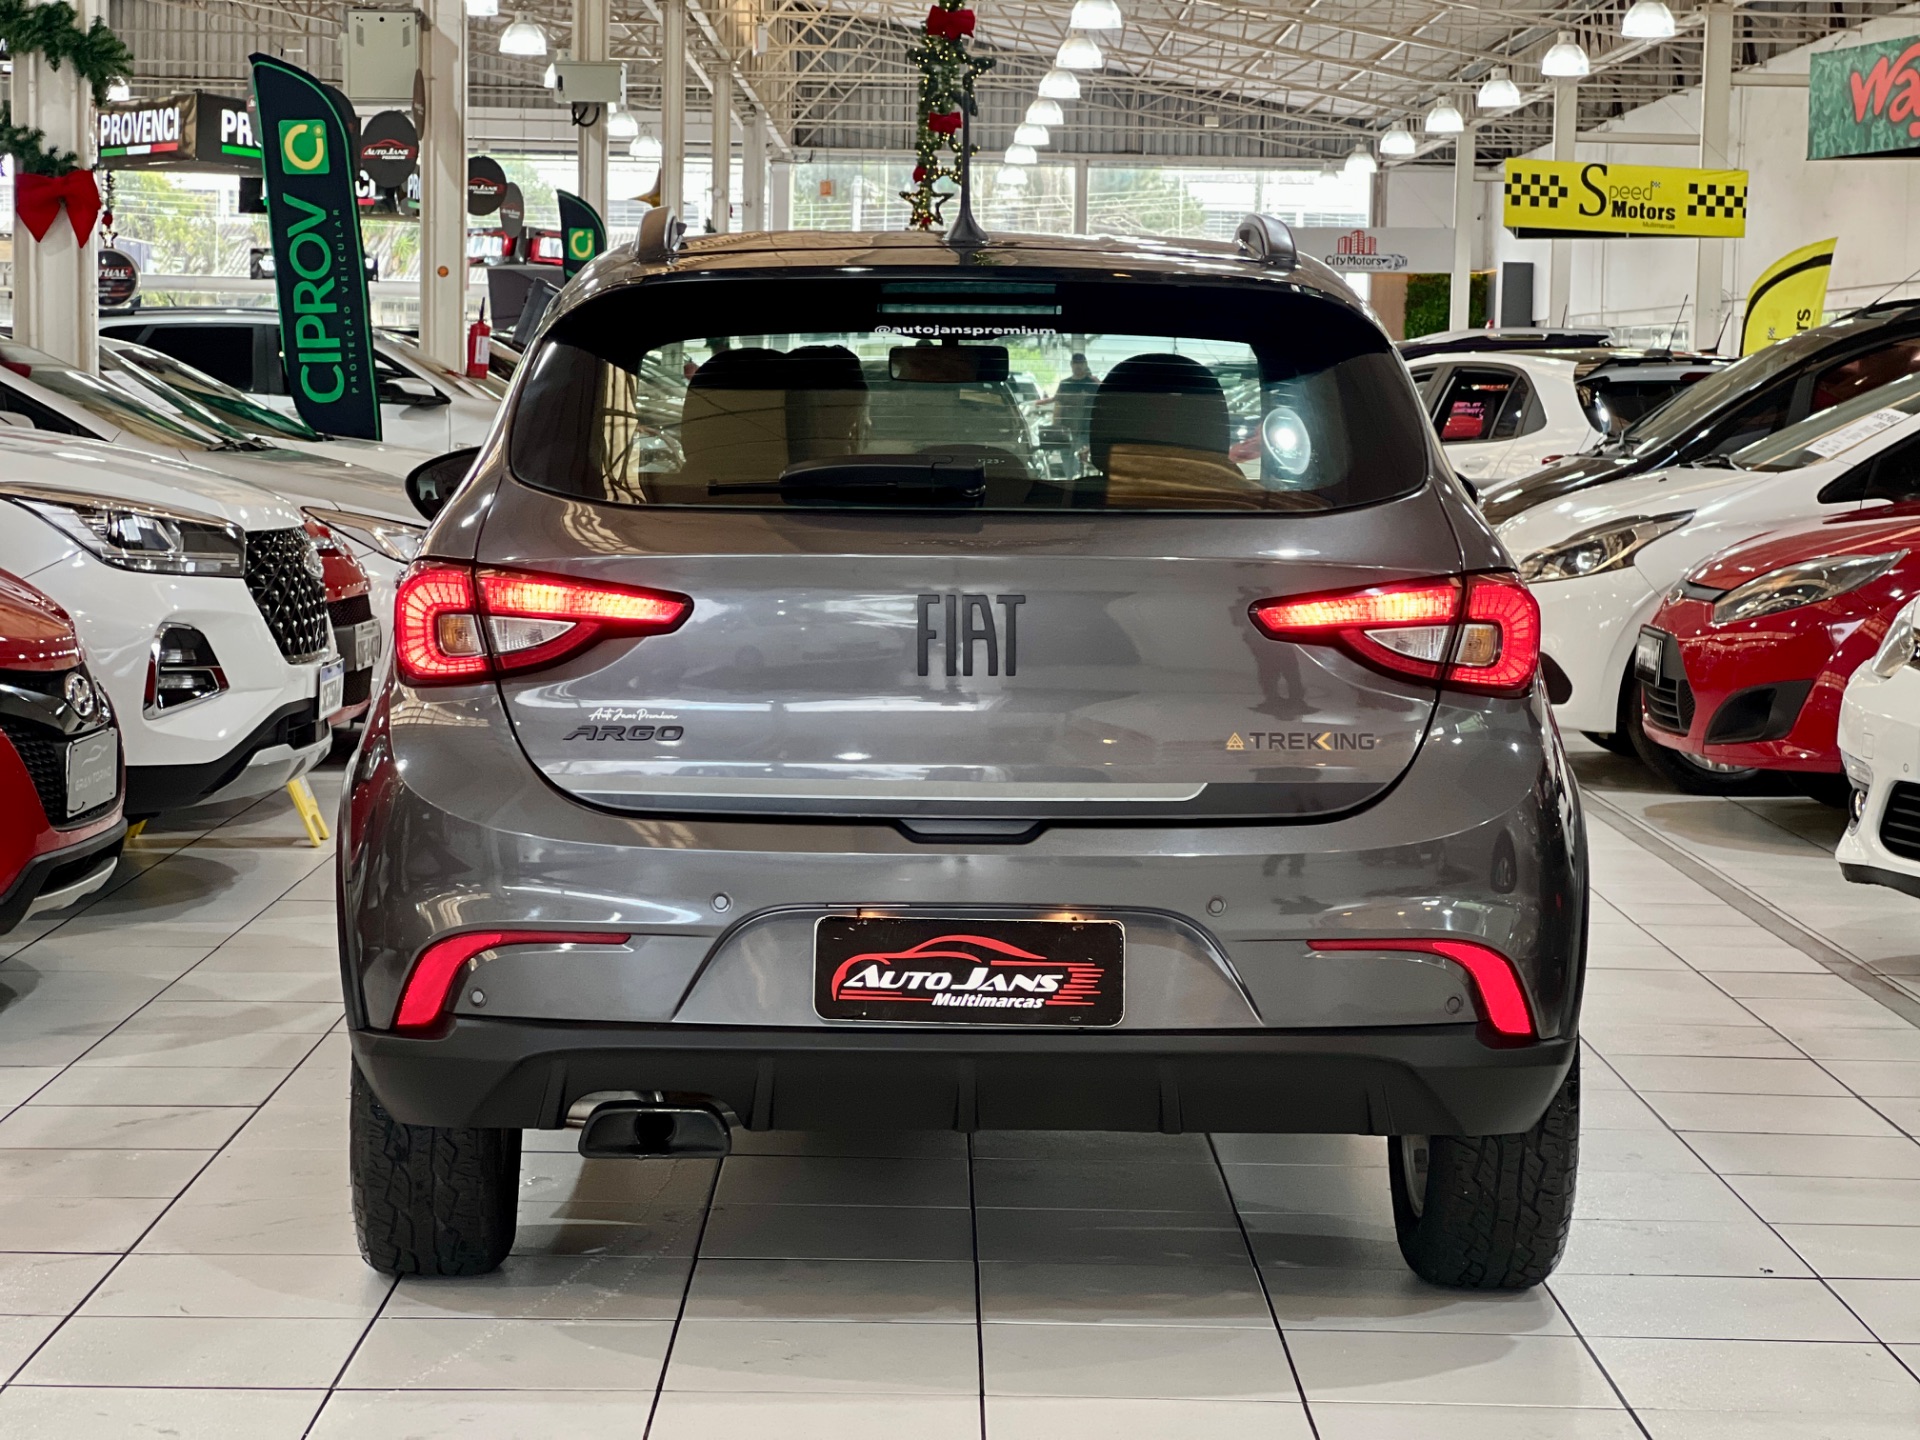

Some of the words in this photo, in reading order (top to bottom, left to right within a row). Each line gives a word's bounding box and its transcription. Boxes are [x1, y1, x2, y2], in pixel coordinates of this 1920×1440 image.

[1850, 42, 1920, 123] Wa
[100, 107, 180, 146] PROVENCI
[221, 109, 262, 147] PR
[364, 148, 387, 156] AUTO
[355, 169, 376, 198] CI
[1579, 163, 1654, 216] Speed
[1611, 200, 1676, 221] Motors
[333, 209, 350, 294] VEICULAR
[1325, 255, 1347, 266] City
[1347, 256, 1382, 266] Motors
[282, 192, 345, 404] CIPROV
[874, 325, 1056, 337] @autojanspremium
[1796, 308, 1811, 330] rs
[917, 594, 1026, 676] FIAT
[588, 708, 615, 721] Auto
[613, 708, 637, 721] Jans
[562, 725, 684, 741] ARGO
[844, 964, 951, 989] AUTO
[950, 967, 1064, 993] JANS
[932, 992, 1045, 1009] Multimarcas
